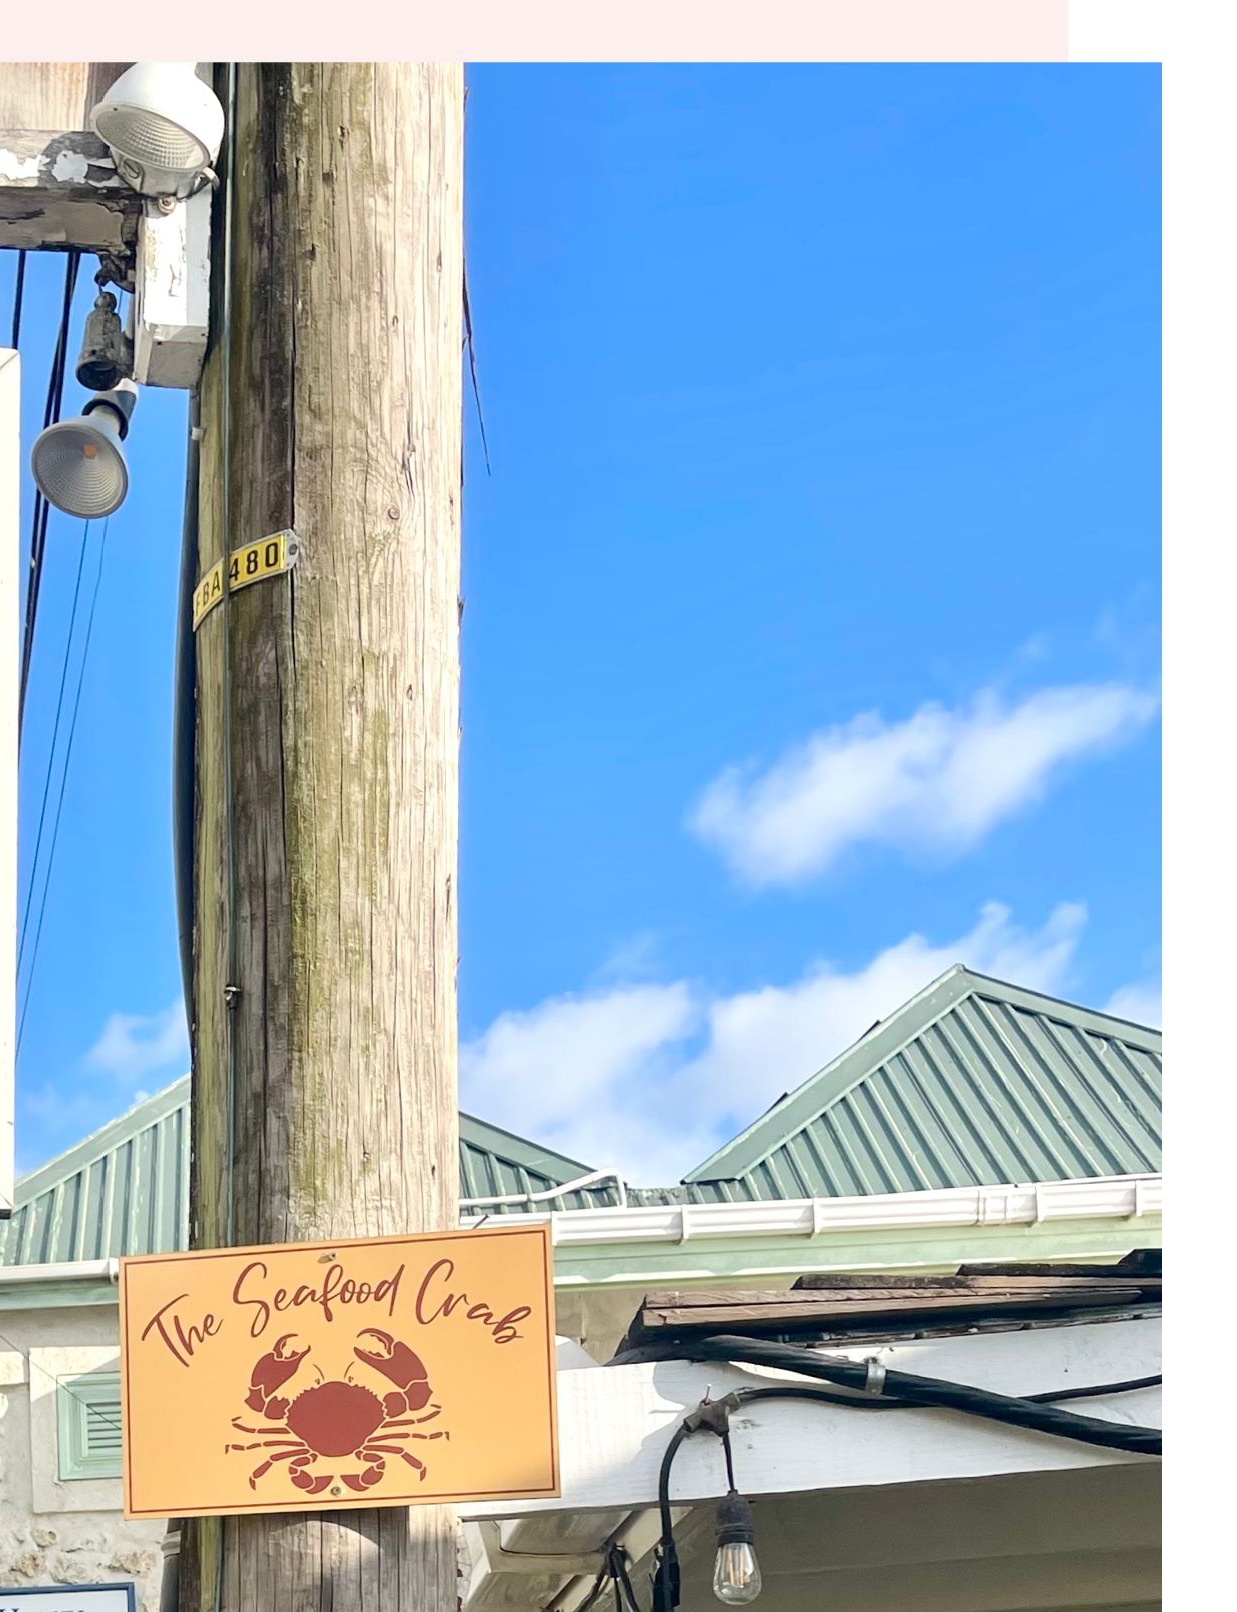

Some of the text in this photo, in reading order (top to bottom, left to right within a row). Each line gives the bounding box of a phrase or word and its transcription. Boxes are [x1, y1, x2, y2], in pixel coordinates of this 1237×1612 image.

[141, 1258, 532, 1368] The Seafood Crab
